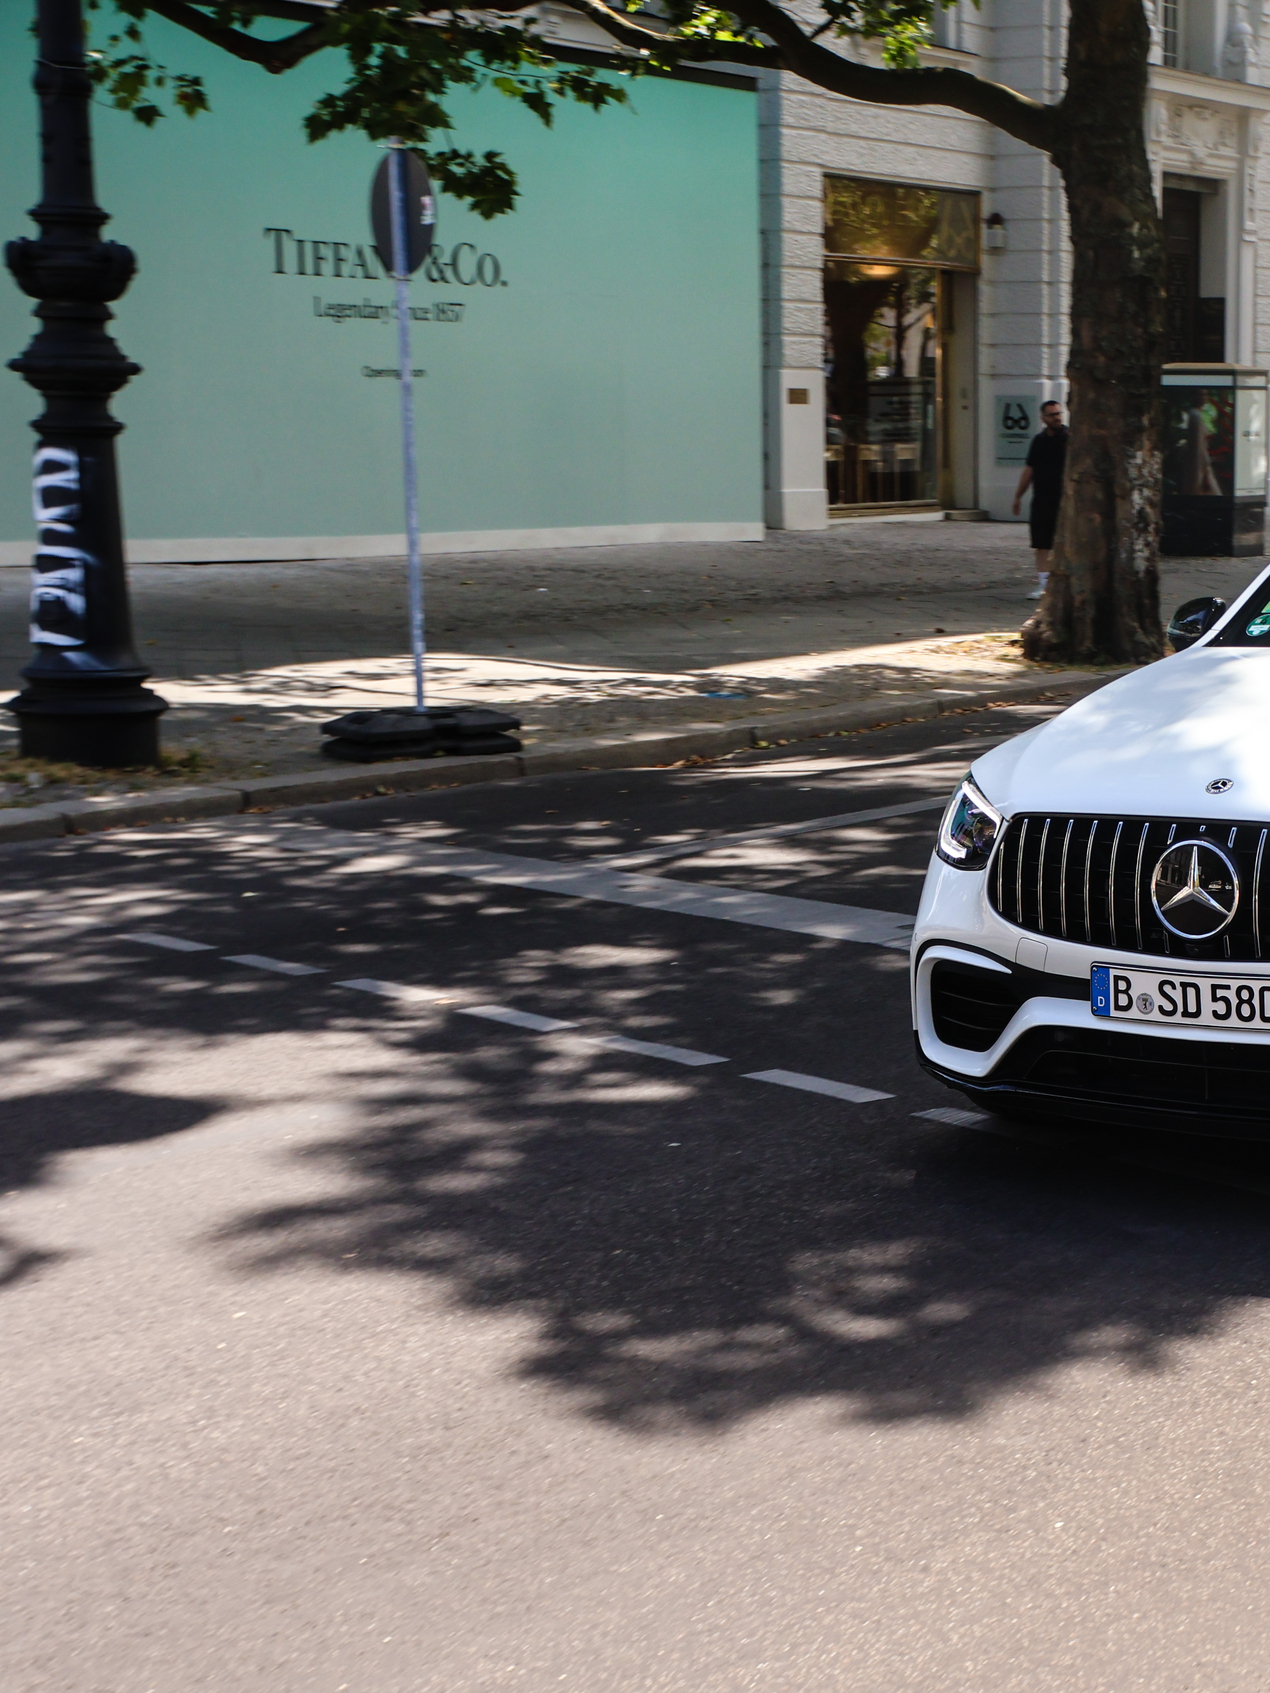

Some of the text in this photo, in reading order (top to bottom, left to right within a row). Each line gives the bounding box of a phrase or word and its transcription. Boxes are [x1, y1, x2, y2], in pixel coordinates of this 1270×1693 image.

[1097, 996, 1105, 1007] D
[1113, 974, 1134, 1012] B
[1157, 979, 1202, 1019] SD
